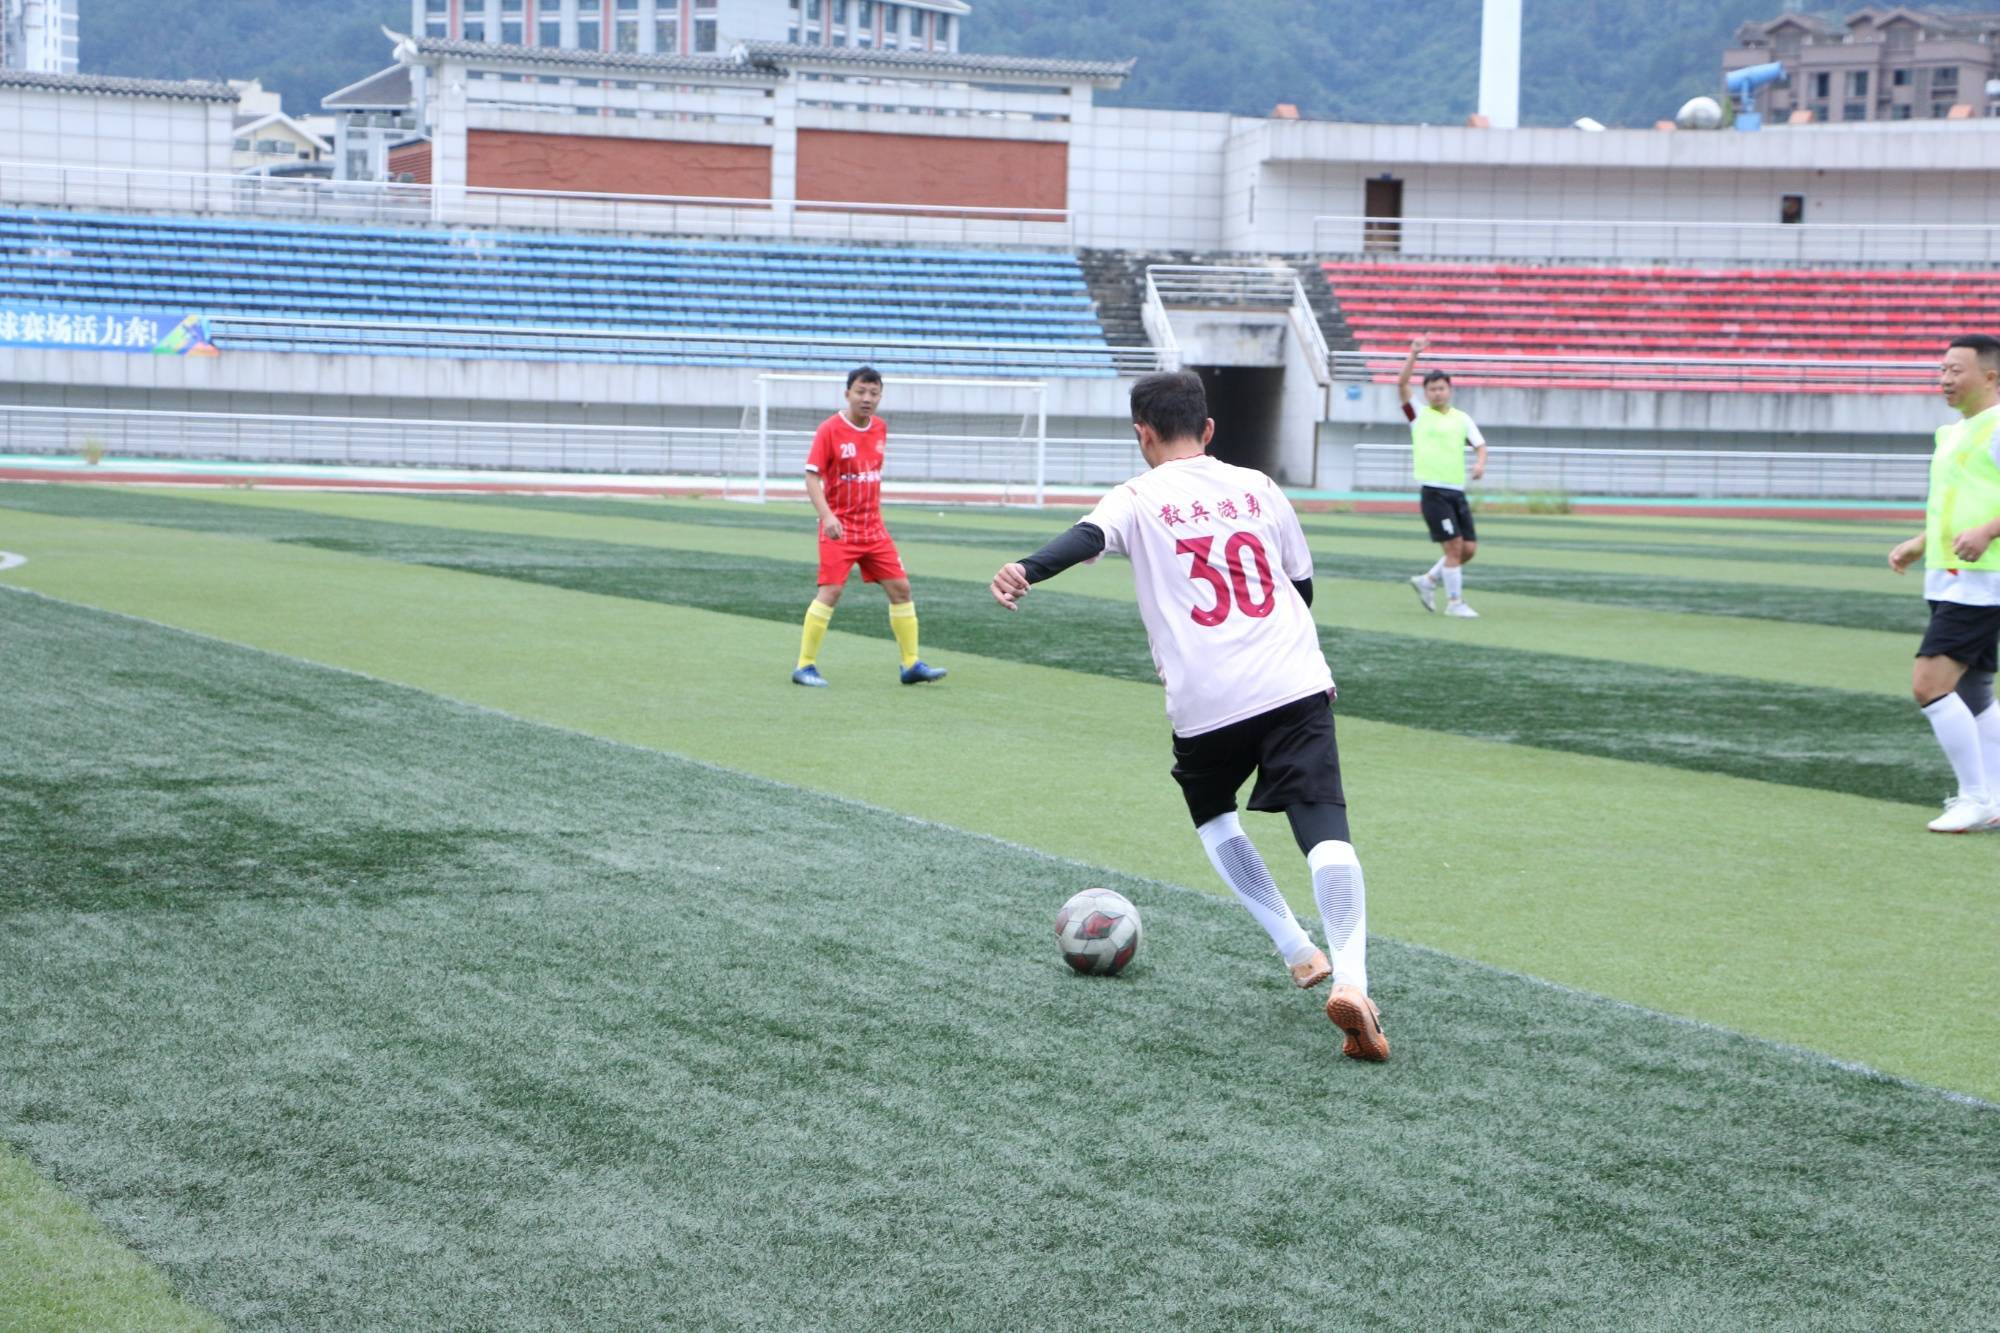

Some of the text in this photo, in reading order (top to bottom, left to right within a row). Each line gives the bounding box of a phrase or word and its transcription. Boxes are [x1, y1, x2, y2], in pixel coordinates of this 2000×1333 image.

[840, 442, 857, 459] 20
[1158, 493, 1261, 527] 散兵游勇
[1176, 531, 1275, 626] 30
